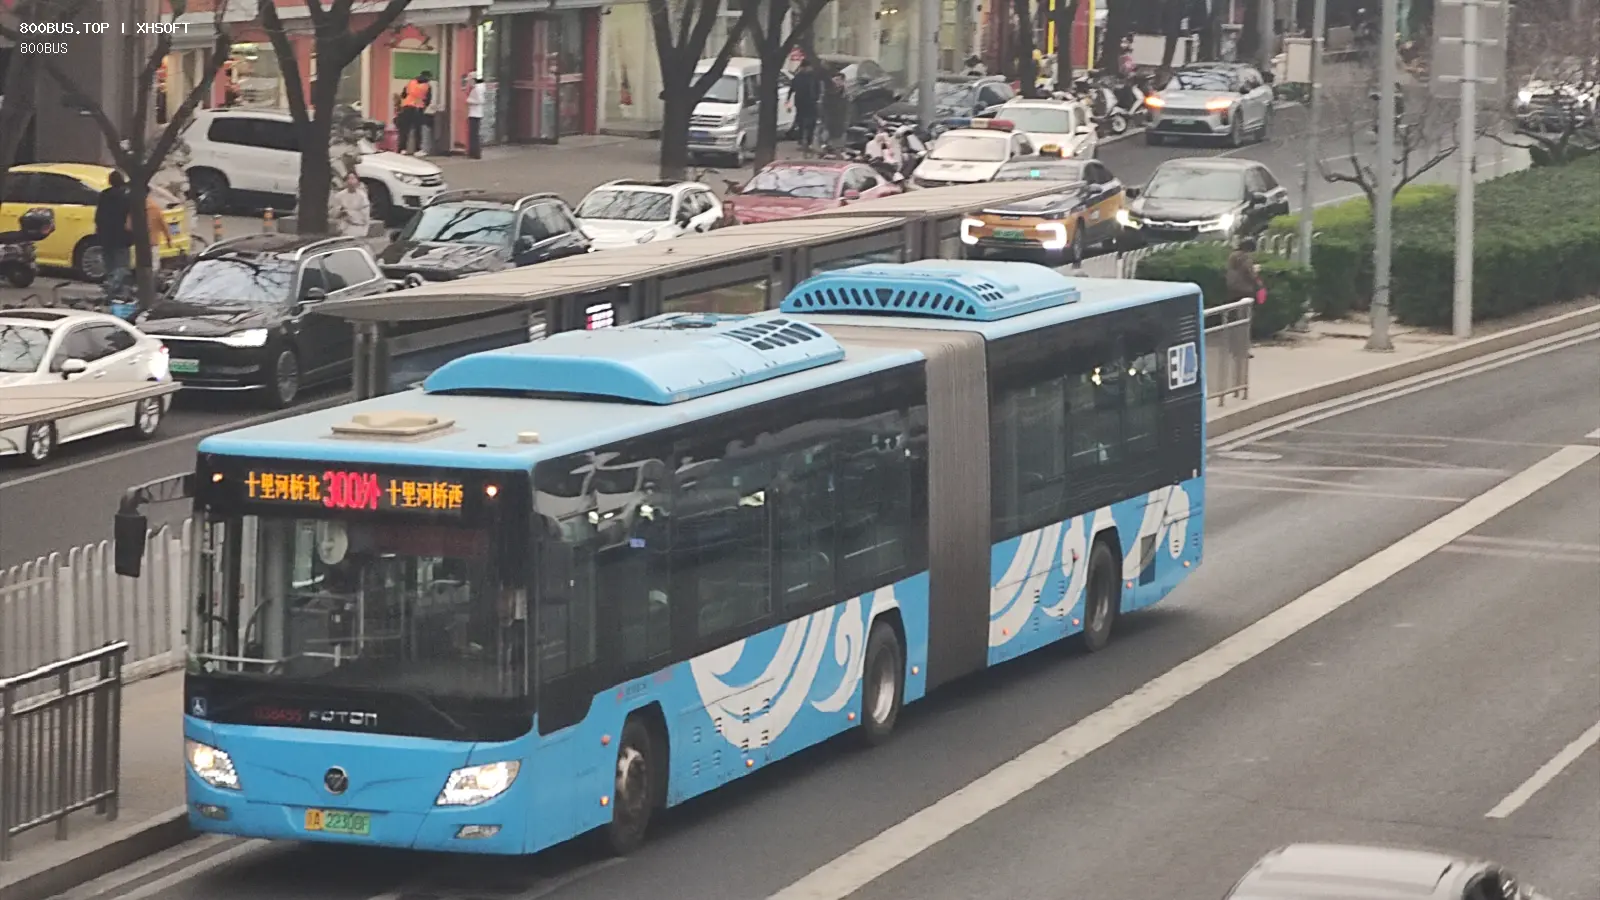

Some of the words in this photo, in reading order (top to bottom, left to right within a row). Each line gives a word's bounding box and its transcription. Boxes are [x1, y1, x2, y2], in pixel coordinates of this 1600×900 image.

[244, 471, 321, 501] 十里河桥北
[385, 479, 464, 509] 十里河桥西
[308, 710, 378, 726] FOTON
